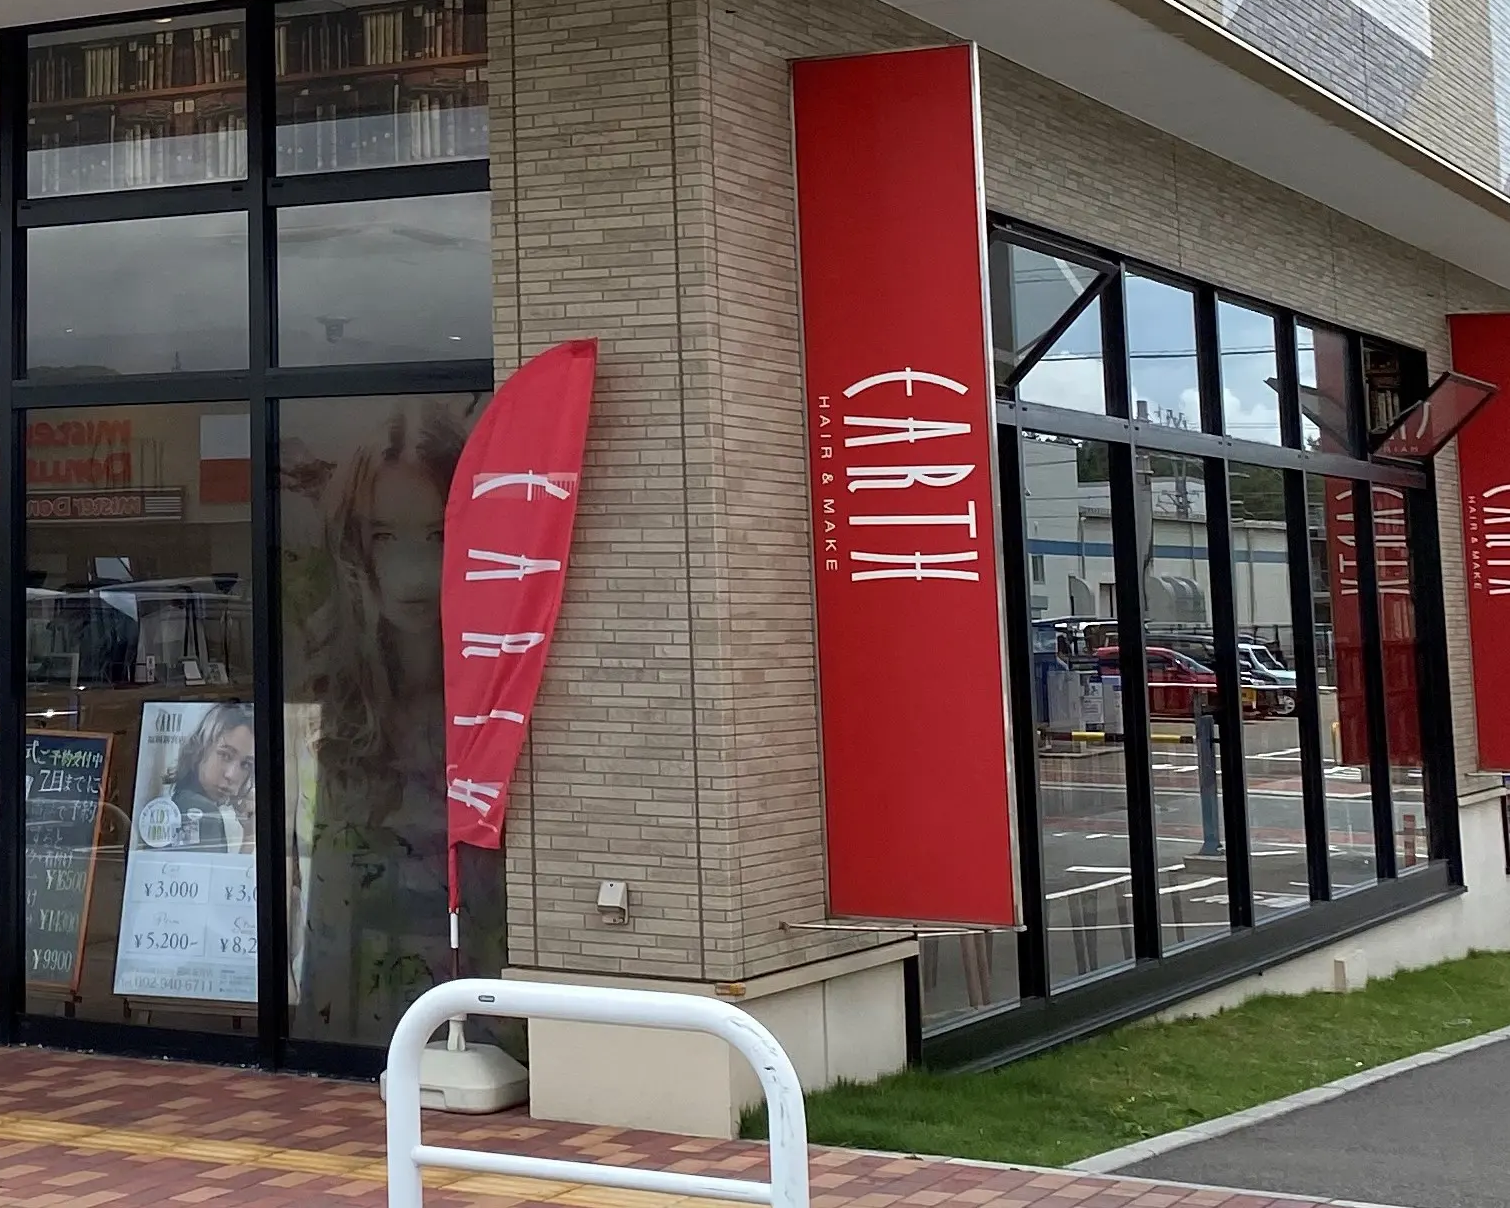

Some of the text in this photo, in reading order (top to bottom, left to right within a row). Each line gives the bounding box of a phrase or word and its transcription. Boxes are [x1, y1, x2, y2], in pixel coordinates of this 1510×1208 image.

[818, 396, 838, 571] HAIR & MAKE
[843, 367, 980, 581] EARTH
[1468, 496, 1479, 531] HAIR
[1472, 550, 1483, 590] MAKE
[144, 880, 199, 899] ¥3,000
[32, 948, 73, 973] ¥9900
